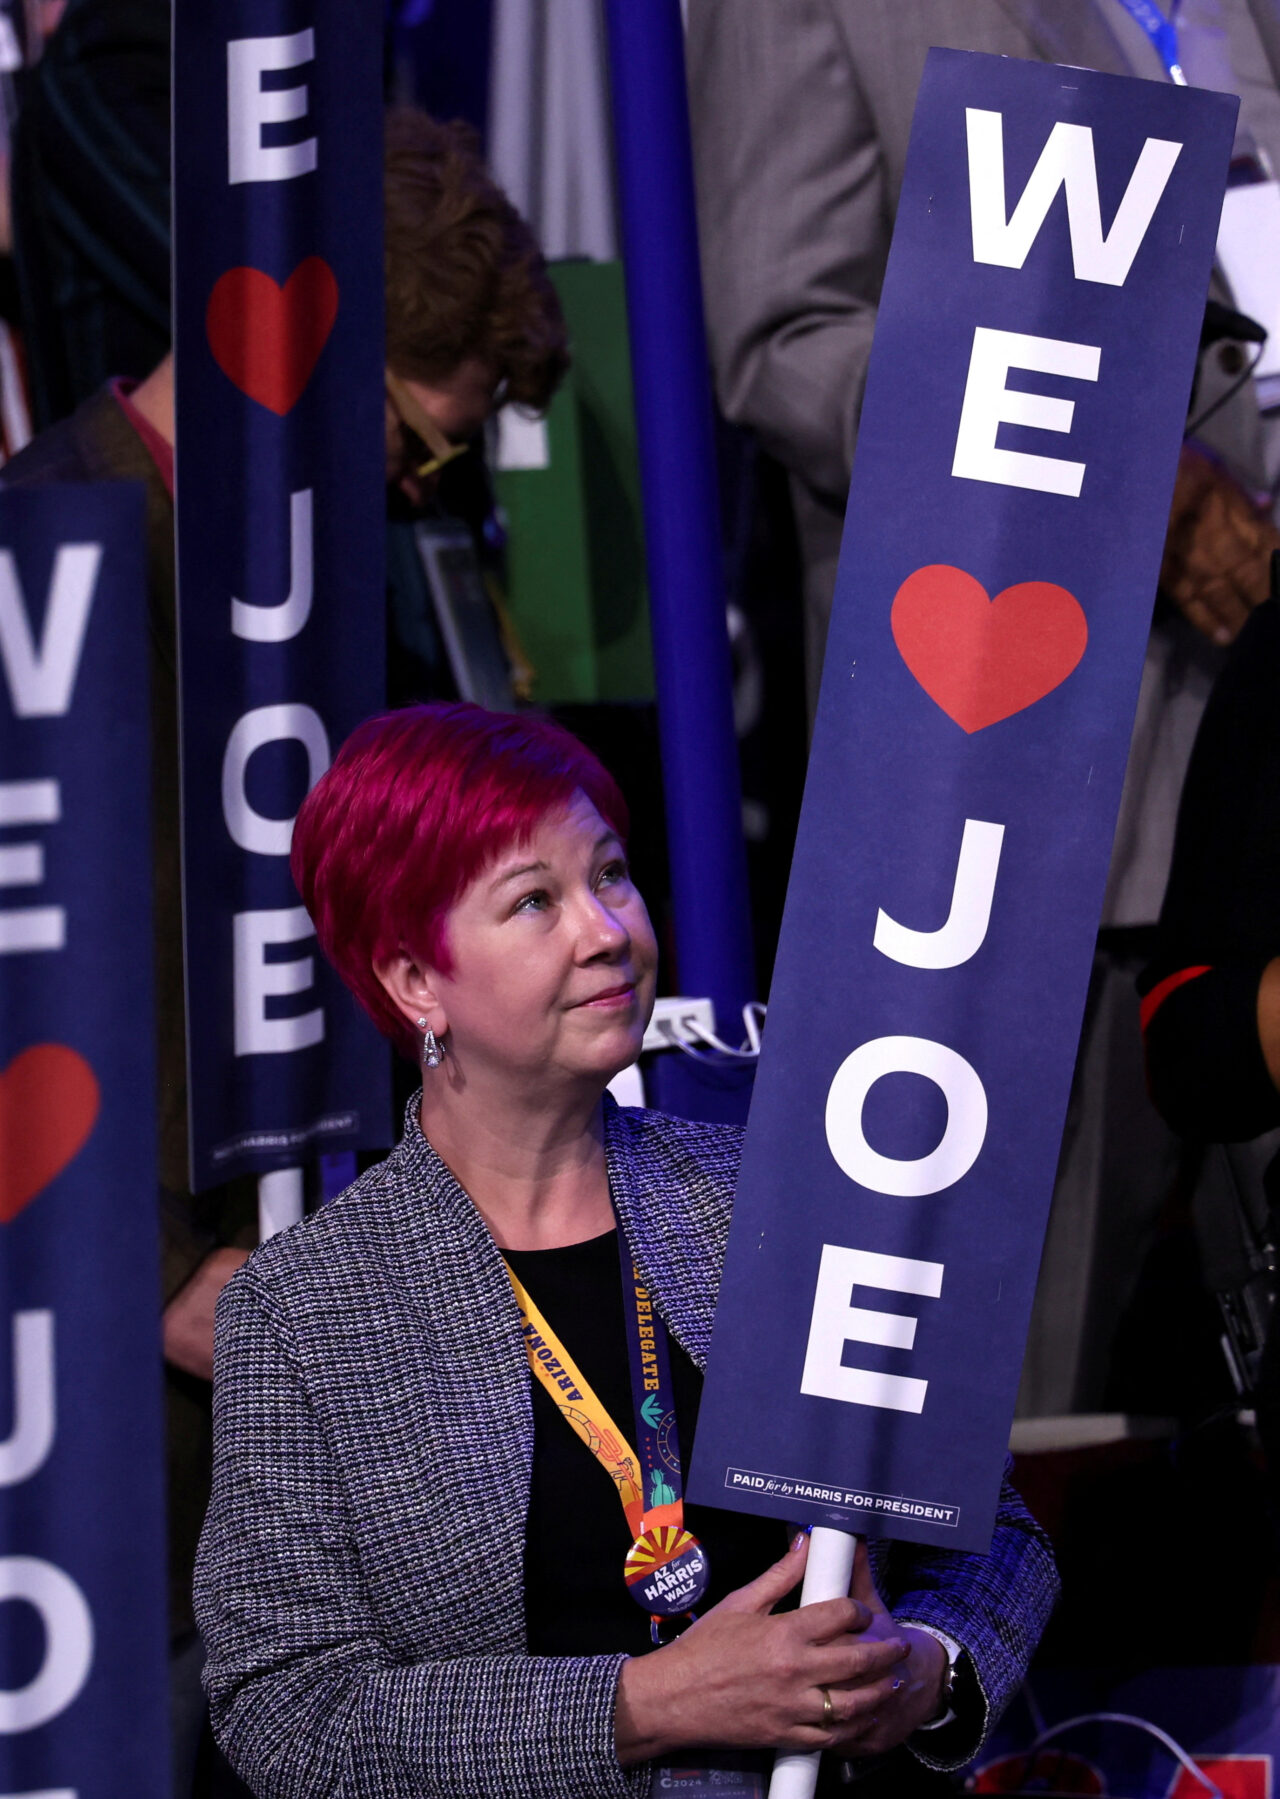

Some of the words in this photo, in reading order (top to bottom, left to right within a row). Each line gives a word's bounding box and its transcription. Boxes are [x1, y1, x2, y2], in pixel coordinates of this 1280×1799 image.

[951, 107, 1183, 498] WE
[223, 488, 330, 1057] JOE
[800, 818, 1006, 1416] JOE
[522, 1323, 584, 1401] ARIZONA
[634, 1287, 660, 1391] DELEGATE
[732, 1473, 764, 1488] PAID
[763, 1480, 781, 1491] for
[781, 1483, 794, 1494] by
[794, 1484, 842, 1502] HARRIS
[844, 1493, 873, 1508] FOR
[874, 1499, 954, 1522] PRESIDENT
[644, 1559, 703, 1601] HARRIS
[654, 1566, 670, 1581] AZ
[671, 1560, 681, 1571] for
[664, 1578, 697, 1603] WALZ
